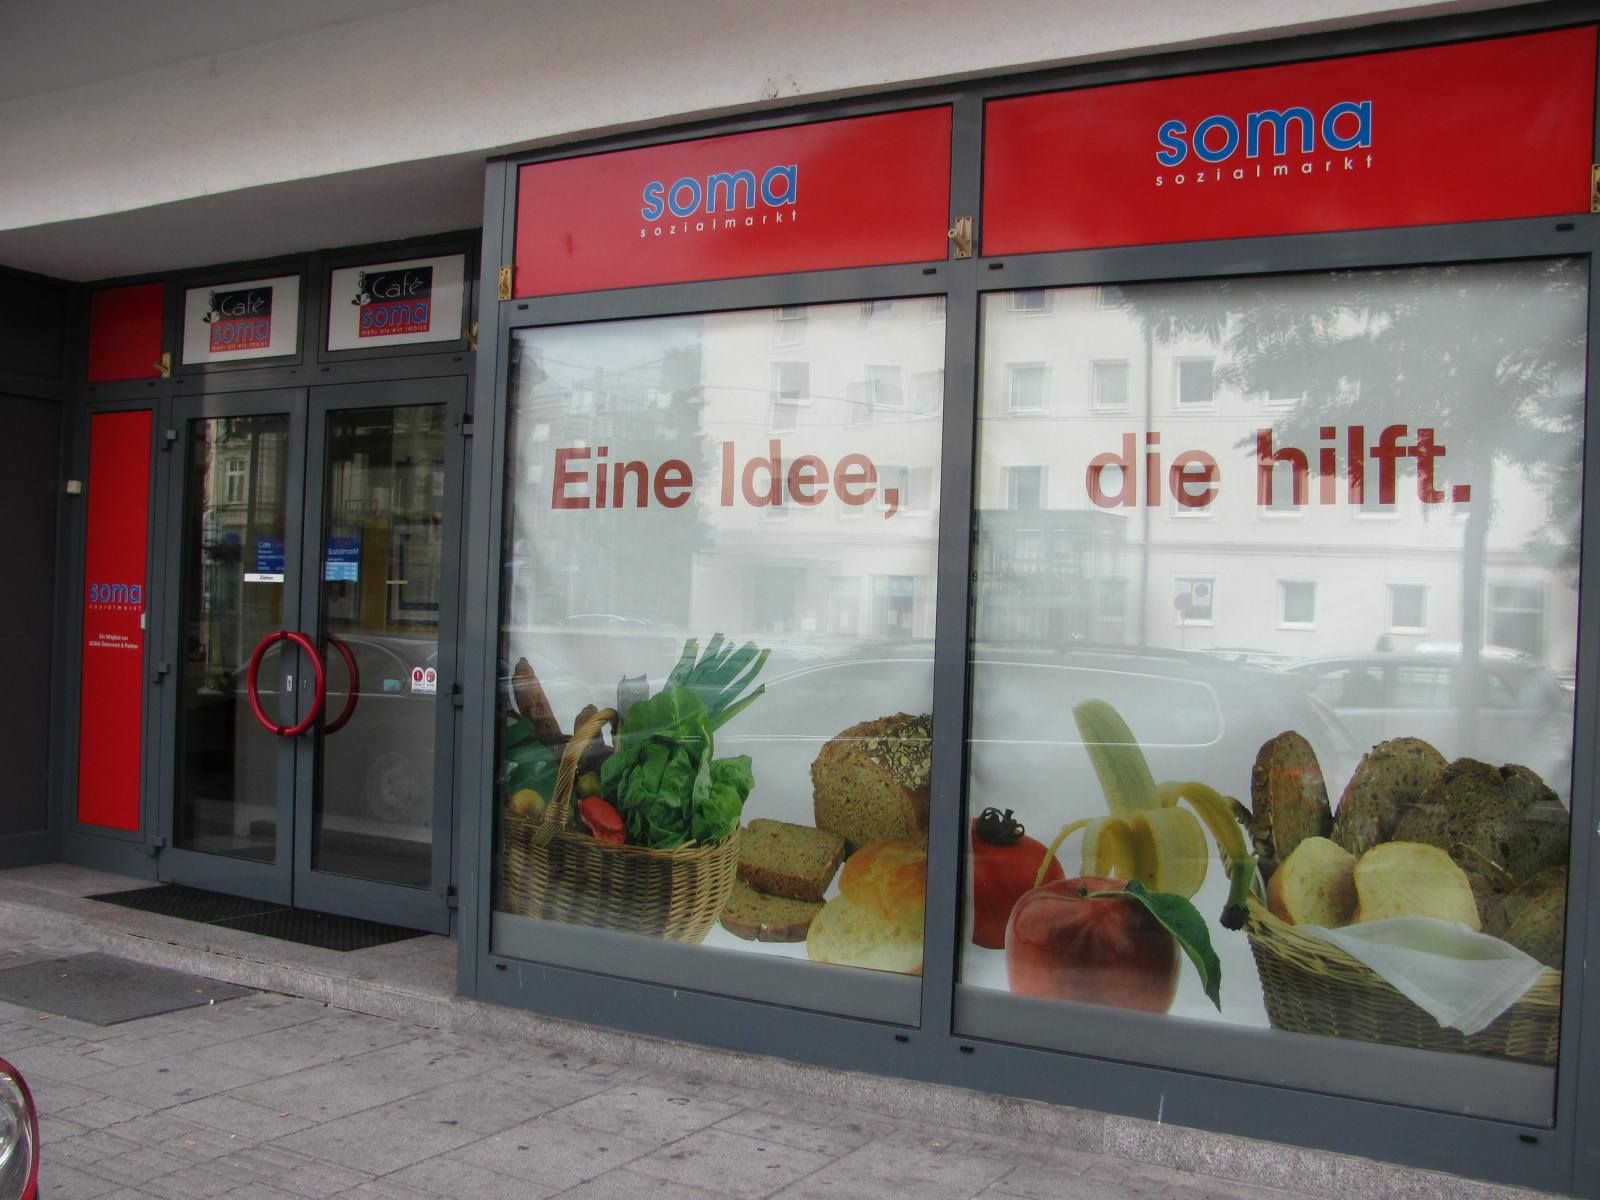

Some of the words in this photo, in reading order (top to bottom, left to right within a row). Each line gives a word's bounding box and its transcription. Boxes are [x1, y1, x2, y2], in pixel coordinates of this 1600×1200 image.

[1155, 100, 1372, 167] soma
[1155, 155, 1373, 186] sozialmarkt
[641, 164, 798, 222] soma
[640, 209, 797, 238] sozialmarkt
[372, 272, 424, 298] Café
[221, 291, 265, 316] Café
[362, 303, 428, 329] soma
[212, 320, 269, 344] soma
[551, 446, 693, 509] Eine
[720, 439, 900, 520] Idee,
[1085, 431, 1221, 508] die
[1256, 424, 1471, 506] hilft.
[90, 583, 142, 603] soma
